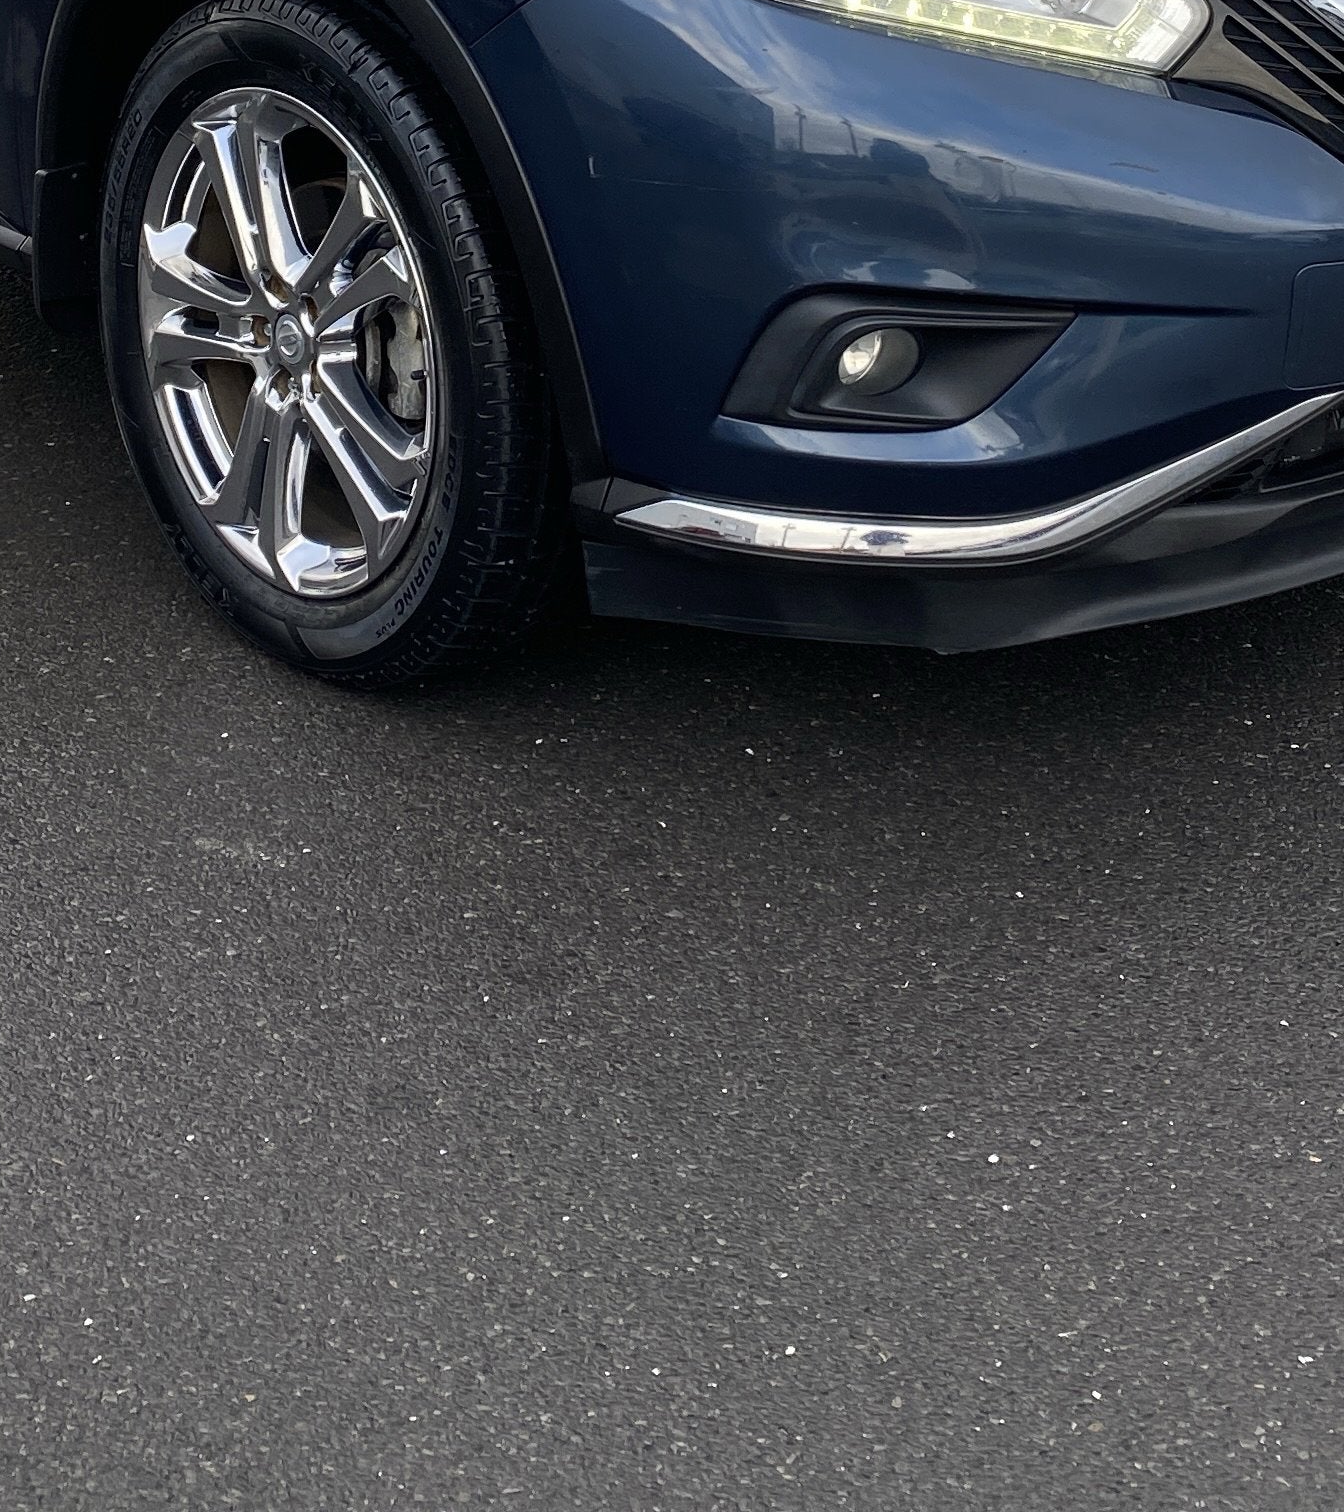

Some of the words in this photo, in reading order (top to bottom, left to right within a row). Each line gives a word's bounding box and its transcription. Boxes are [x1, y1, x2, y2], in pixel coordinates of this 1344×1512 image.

[440, 433, 459, 513] EDGE
[393, 526, 444, 616] TOURING
[375, 618, 397, 639] PLUS
